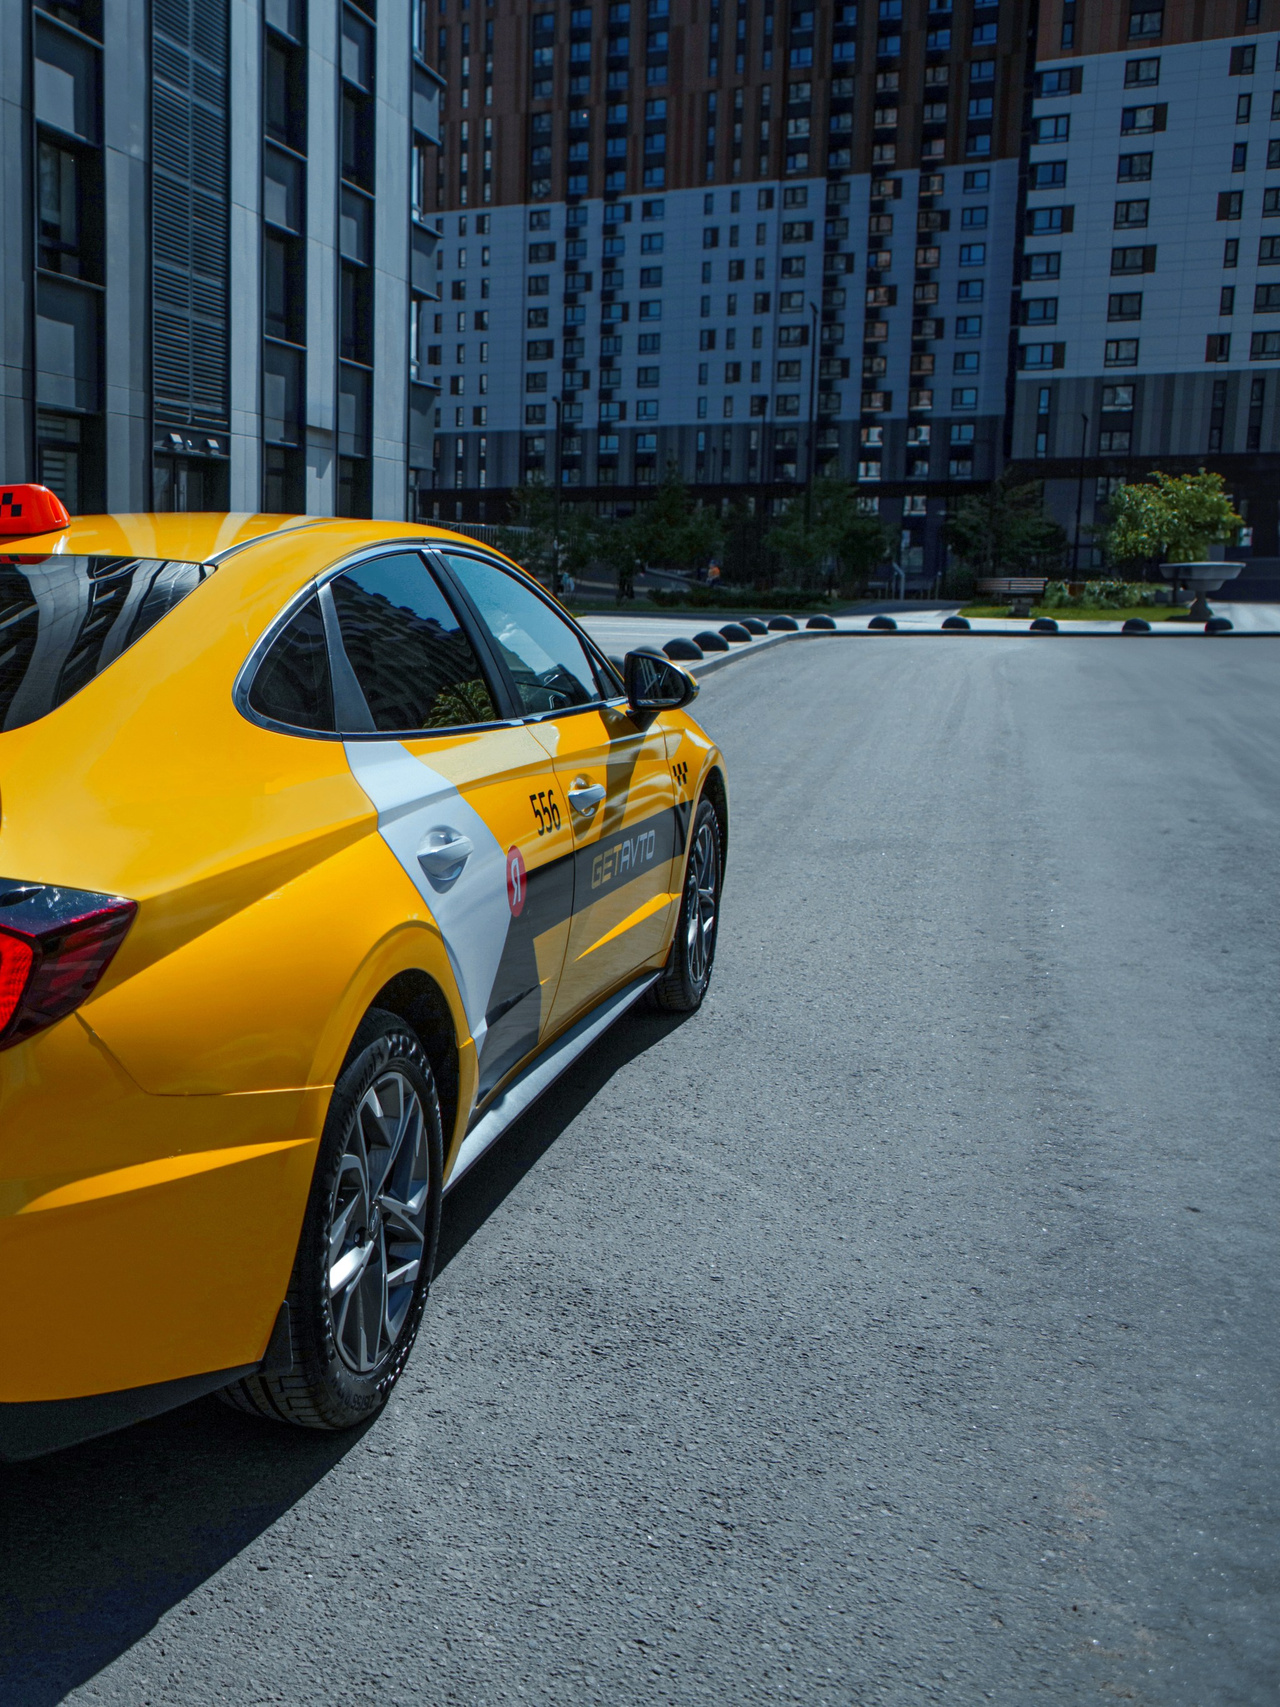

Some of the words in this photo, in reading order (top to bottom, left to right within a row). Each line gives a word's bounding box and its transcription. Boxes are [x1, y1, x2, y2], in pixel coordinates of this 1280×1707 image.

[529, 789, 561, 836] 556
[511, 857, 521, 906] Я
[591, 829, 656, 889] GETAVTO
